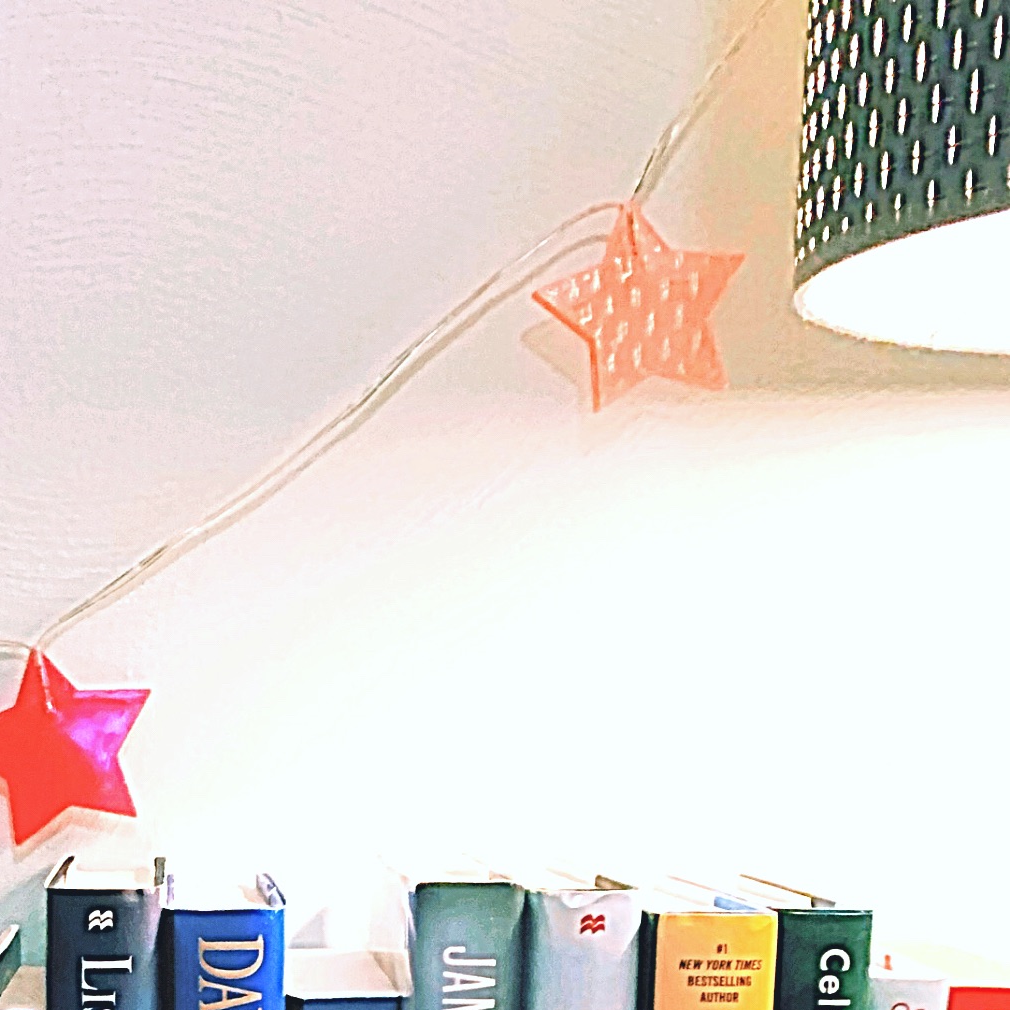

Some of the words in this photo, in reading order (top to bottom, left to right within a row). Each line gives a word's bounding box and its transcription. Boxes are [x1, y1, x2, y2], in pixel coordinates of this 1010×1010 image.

[679, 959, 703, 970] NEW
[706, 959, 732, 970] YORK
[735, 959, 762, 970] TIMES
[687, 975, 752, 987] BESTSELLING
[700, 991, 739, 1003] AUTHOR
